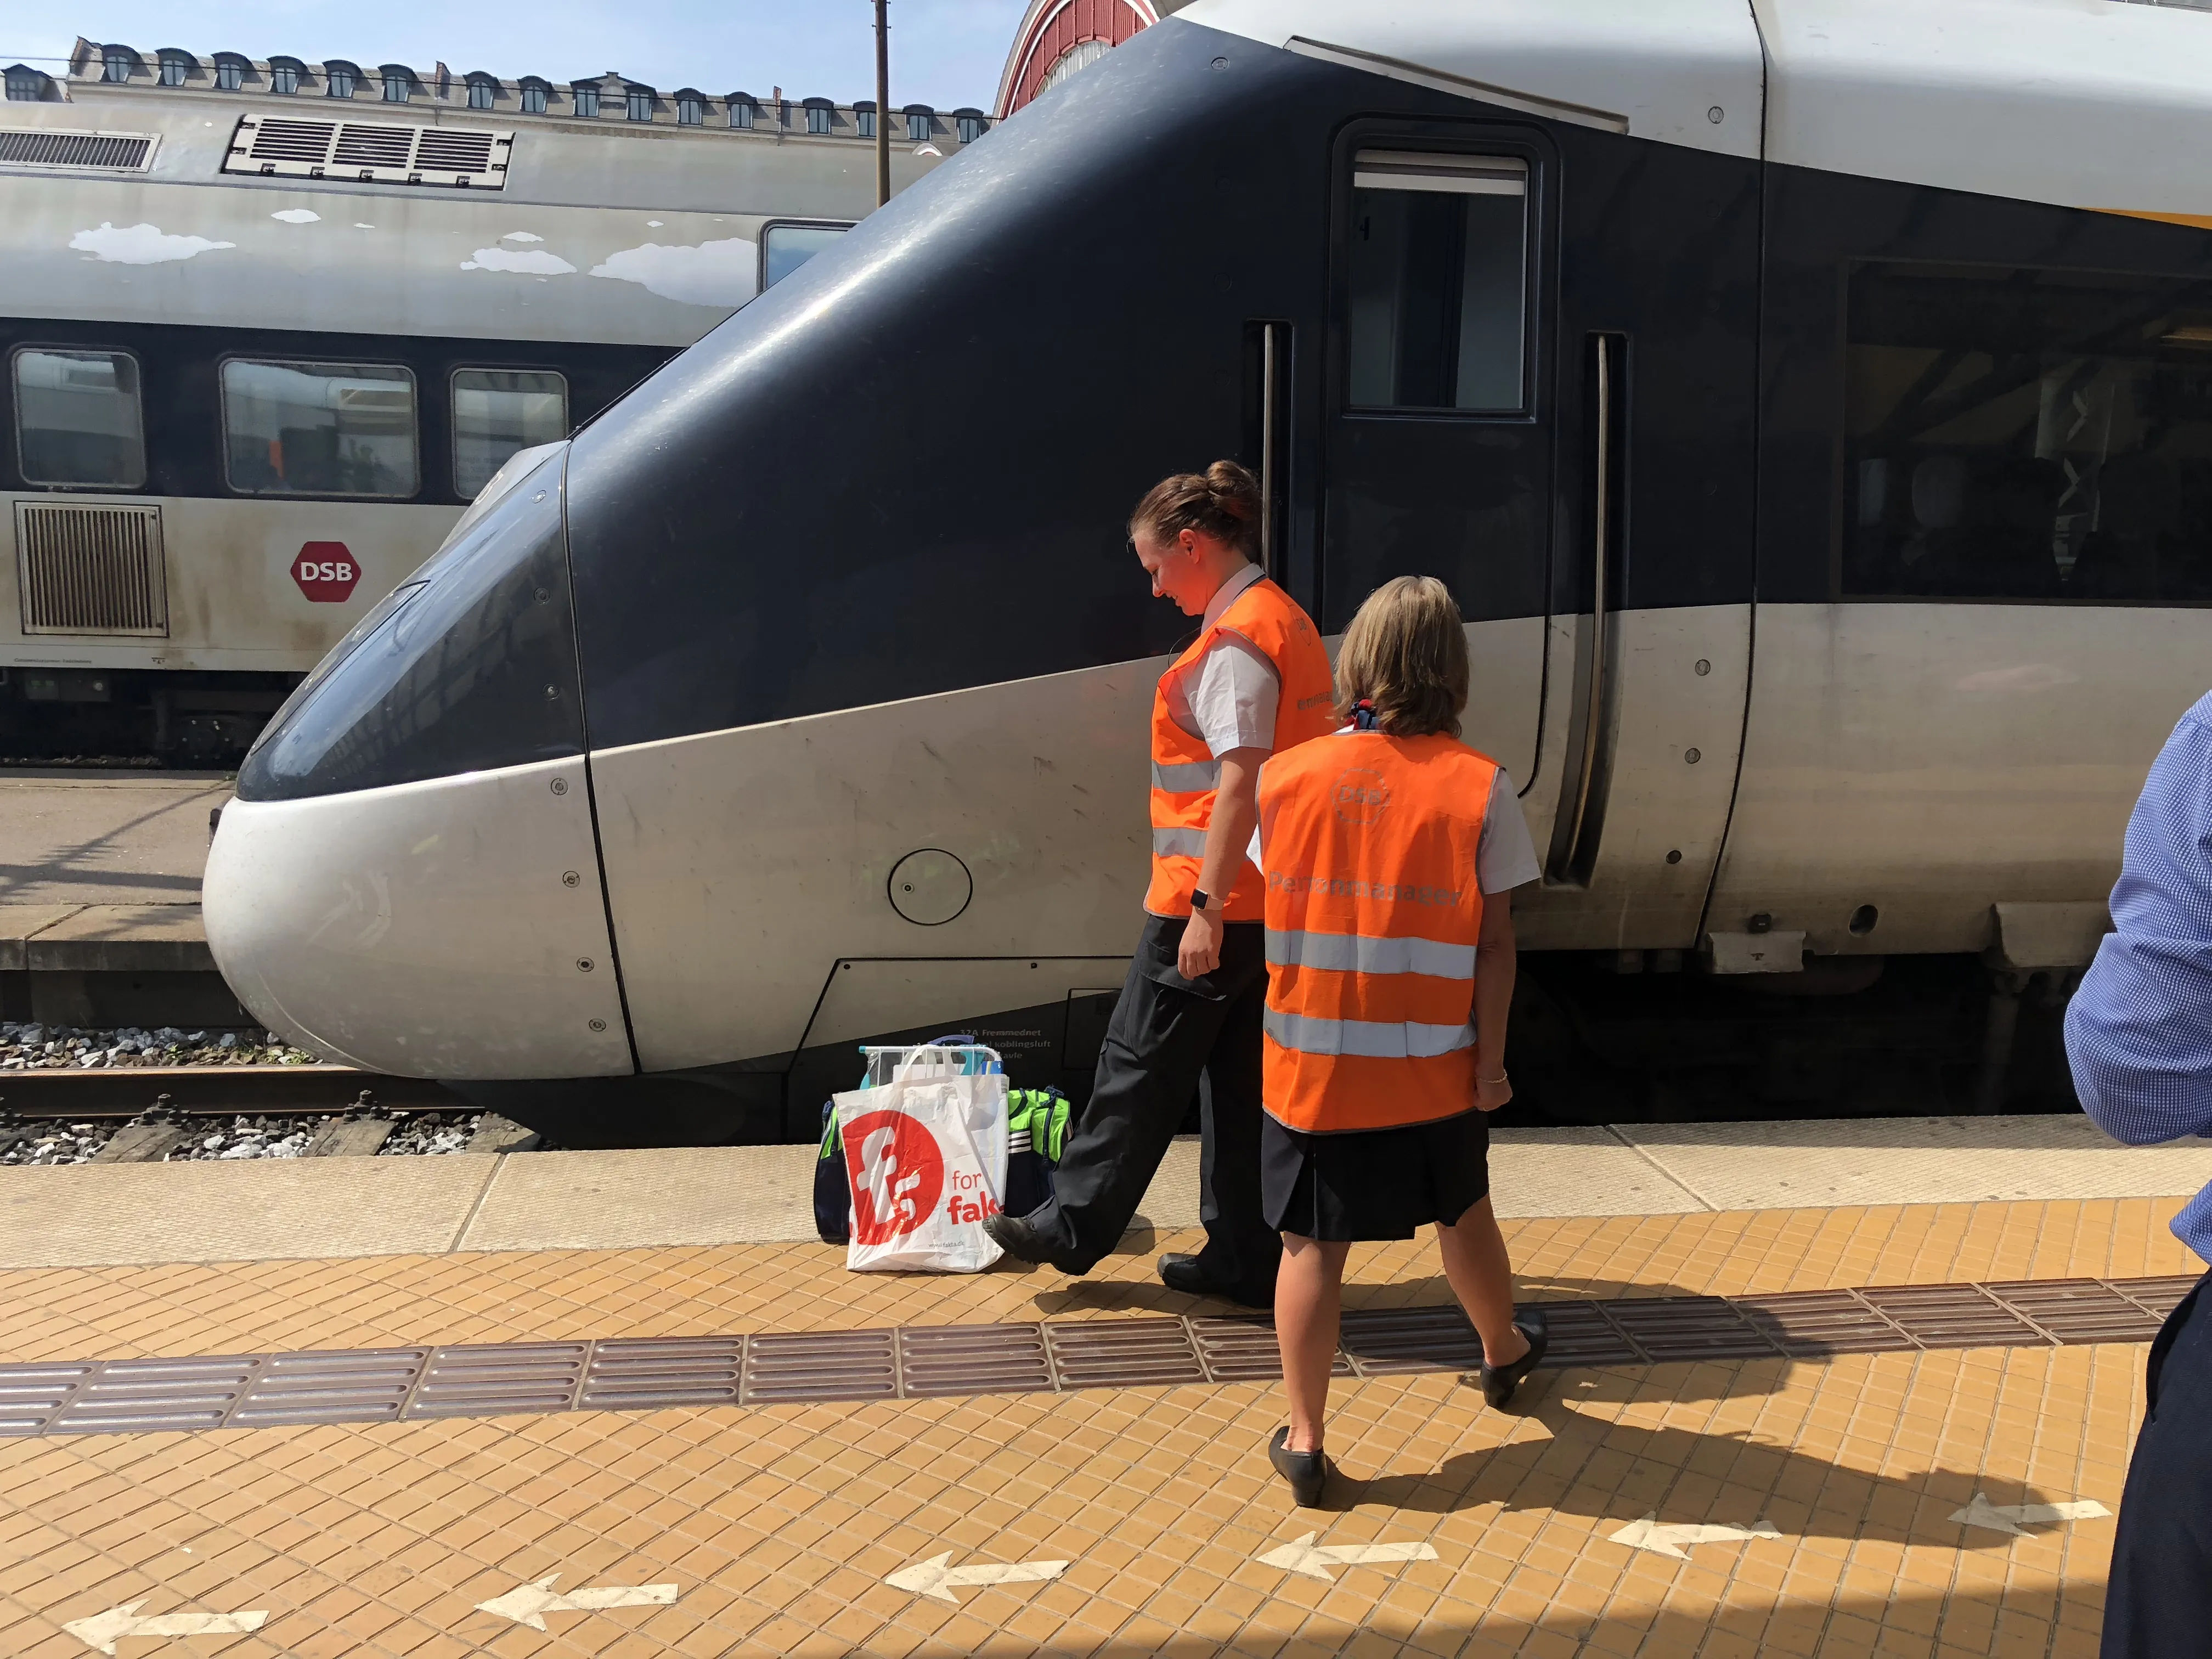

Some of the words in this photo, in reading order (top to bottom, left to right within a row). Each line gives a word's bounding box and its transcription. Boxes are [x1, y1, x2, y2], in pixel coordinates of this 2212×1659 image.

[301, 562, 352, 581] DSB
[1339, 785, 1381, 805] DSB
[1268, 870, 1462, 906] Perronmanager
[952, 1170, 982, 1190] for
